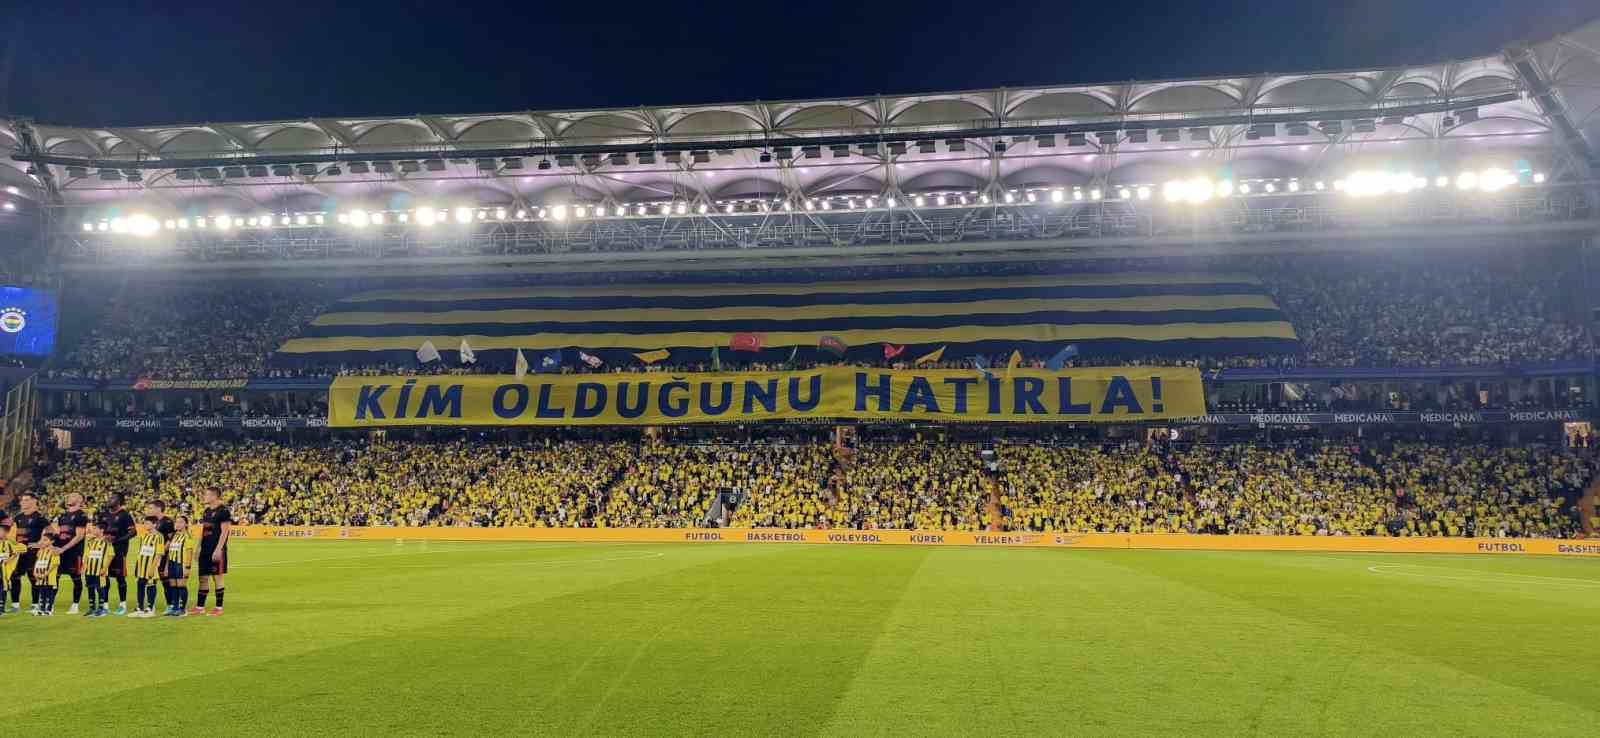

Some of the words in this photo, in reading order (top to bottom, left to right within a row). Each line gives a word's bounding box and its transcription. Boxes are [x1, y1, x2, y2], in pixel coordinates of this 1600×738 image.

[354, 379, 464, 419] KİM
[492, 374, 822, 420] OLDUĞUNU
[854, 372, 1164, 415] HATIRLA!
[1250, 413, 1303, 424] MEDICANA
[1335, 413, 1388, 423] MEDICANA
[1420, 413, 1476, 422] MEDICANA
[1510, 410, 1572, 421] MEDICANA
[116, 418, 155, 427] MEDICANA
[179, 419, 218, 427] MEDICANA
[242, 418, 282, 427] MEDICANA
[685, 532, 724, 541] FUTBOL
[747, 532, 807, 542] BASKETBOL
[828, 533, 881, 542] VOLEYBOL
[909, 534, 945, 544] KÜREK
[1477, 543, 1526, 552] FUTBOL
